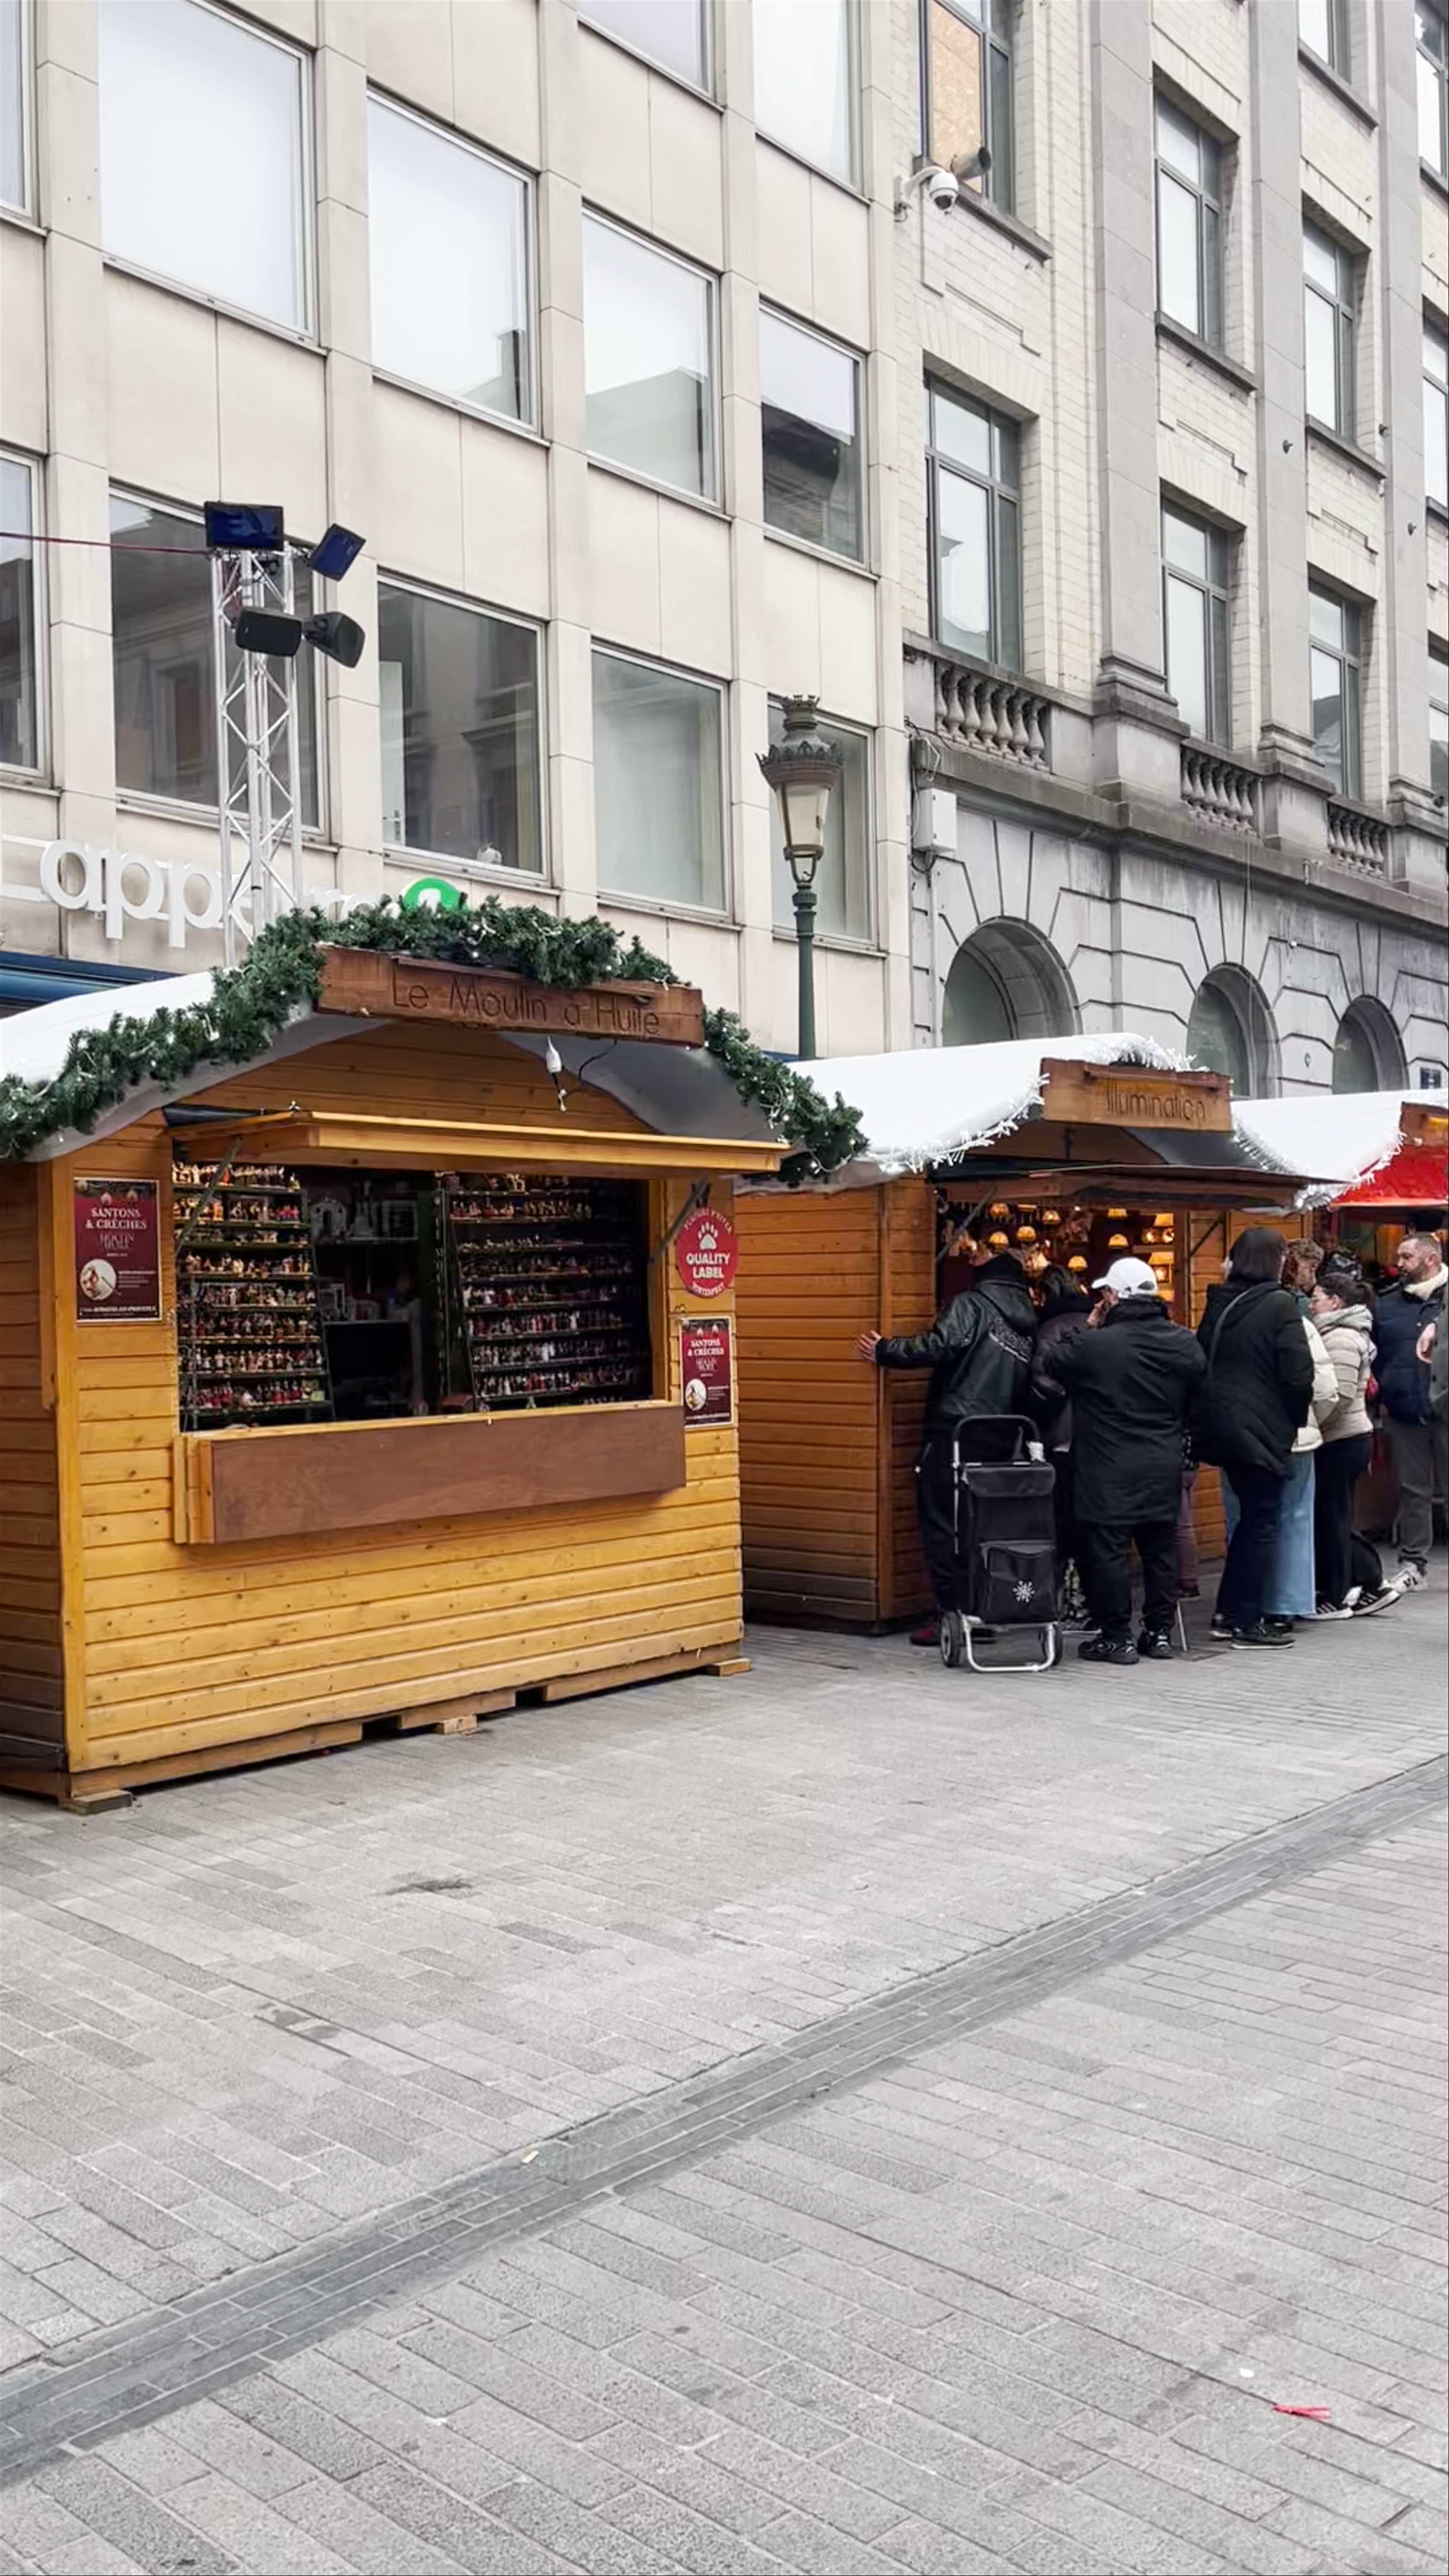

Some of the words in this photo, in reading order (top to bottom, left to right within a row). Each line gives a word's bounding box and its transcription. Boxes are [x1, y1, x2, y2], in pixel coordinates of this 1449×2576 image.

[392, 964, 429, 1009] Le
[450, 975, 547, 1023] Moulin
[597, 995, 660, 1035] Huile
[1106, 1078, 1206, 1123] Illumination
[91, 1208, 141, 1218] SANTONS
[86, 1219, 94, 1229] &
[686, 1253, 730, 1265] QUALITY
[693, 1267, 724, 1278] LABEL
